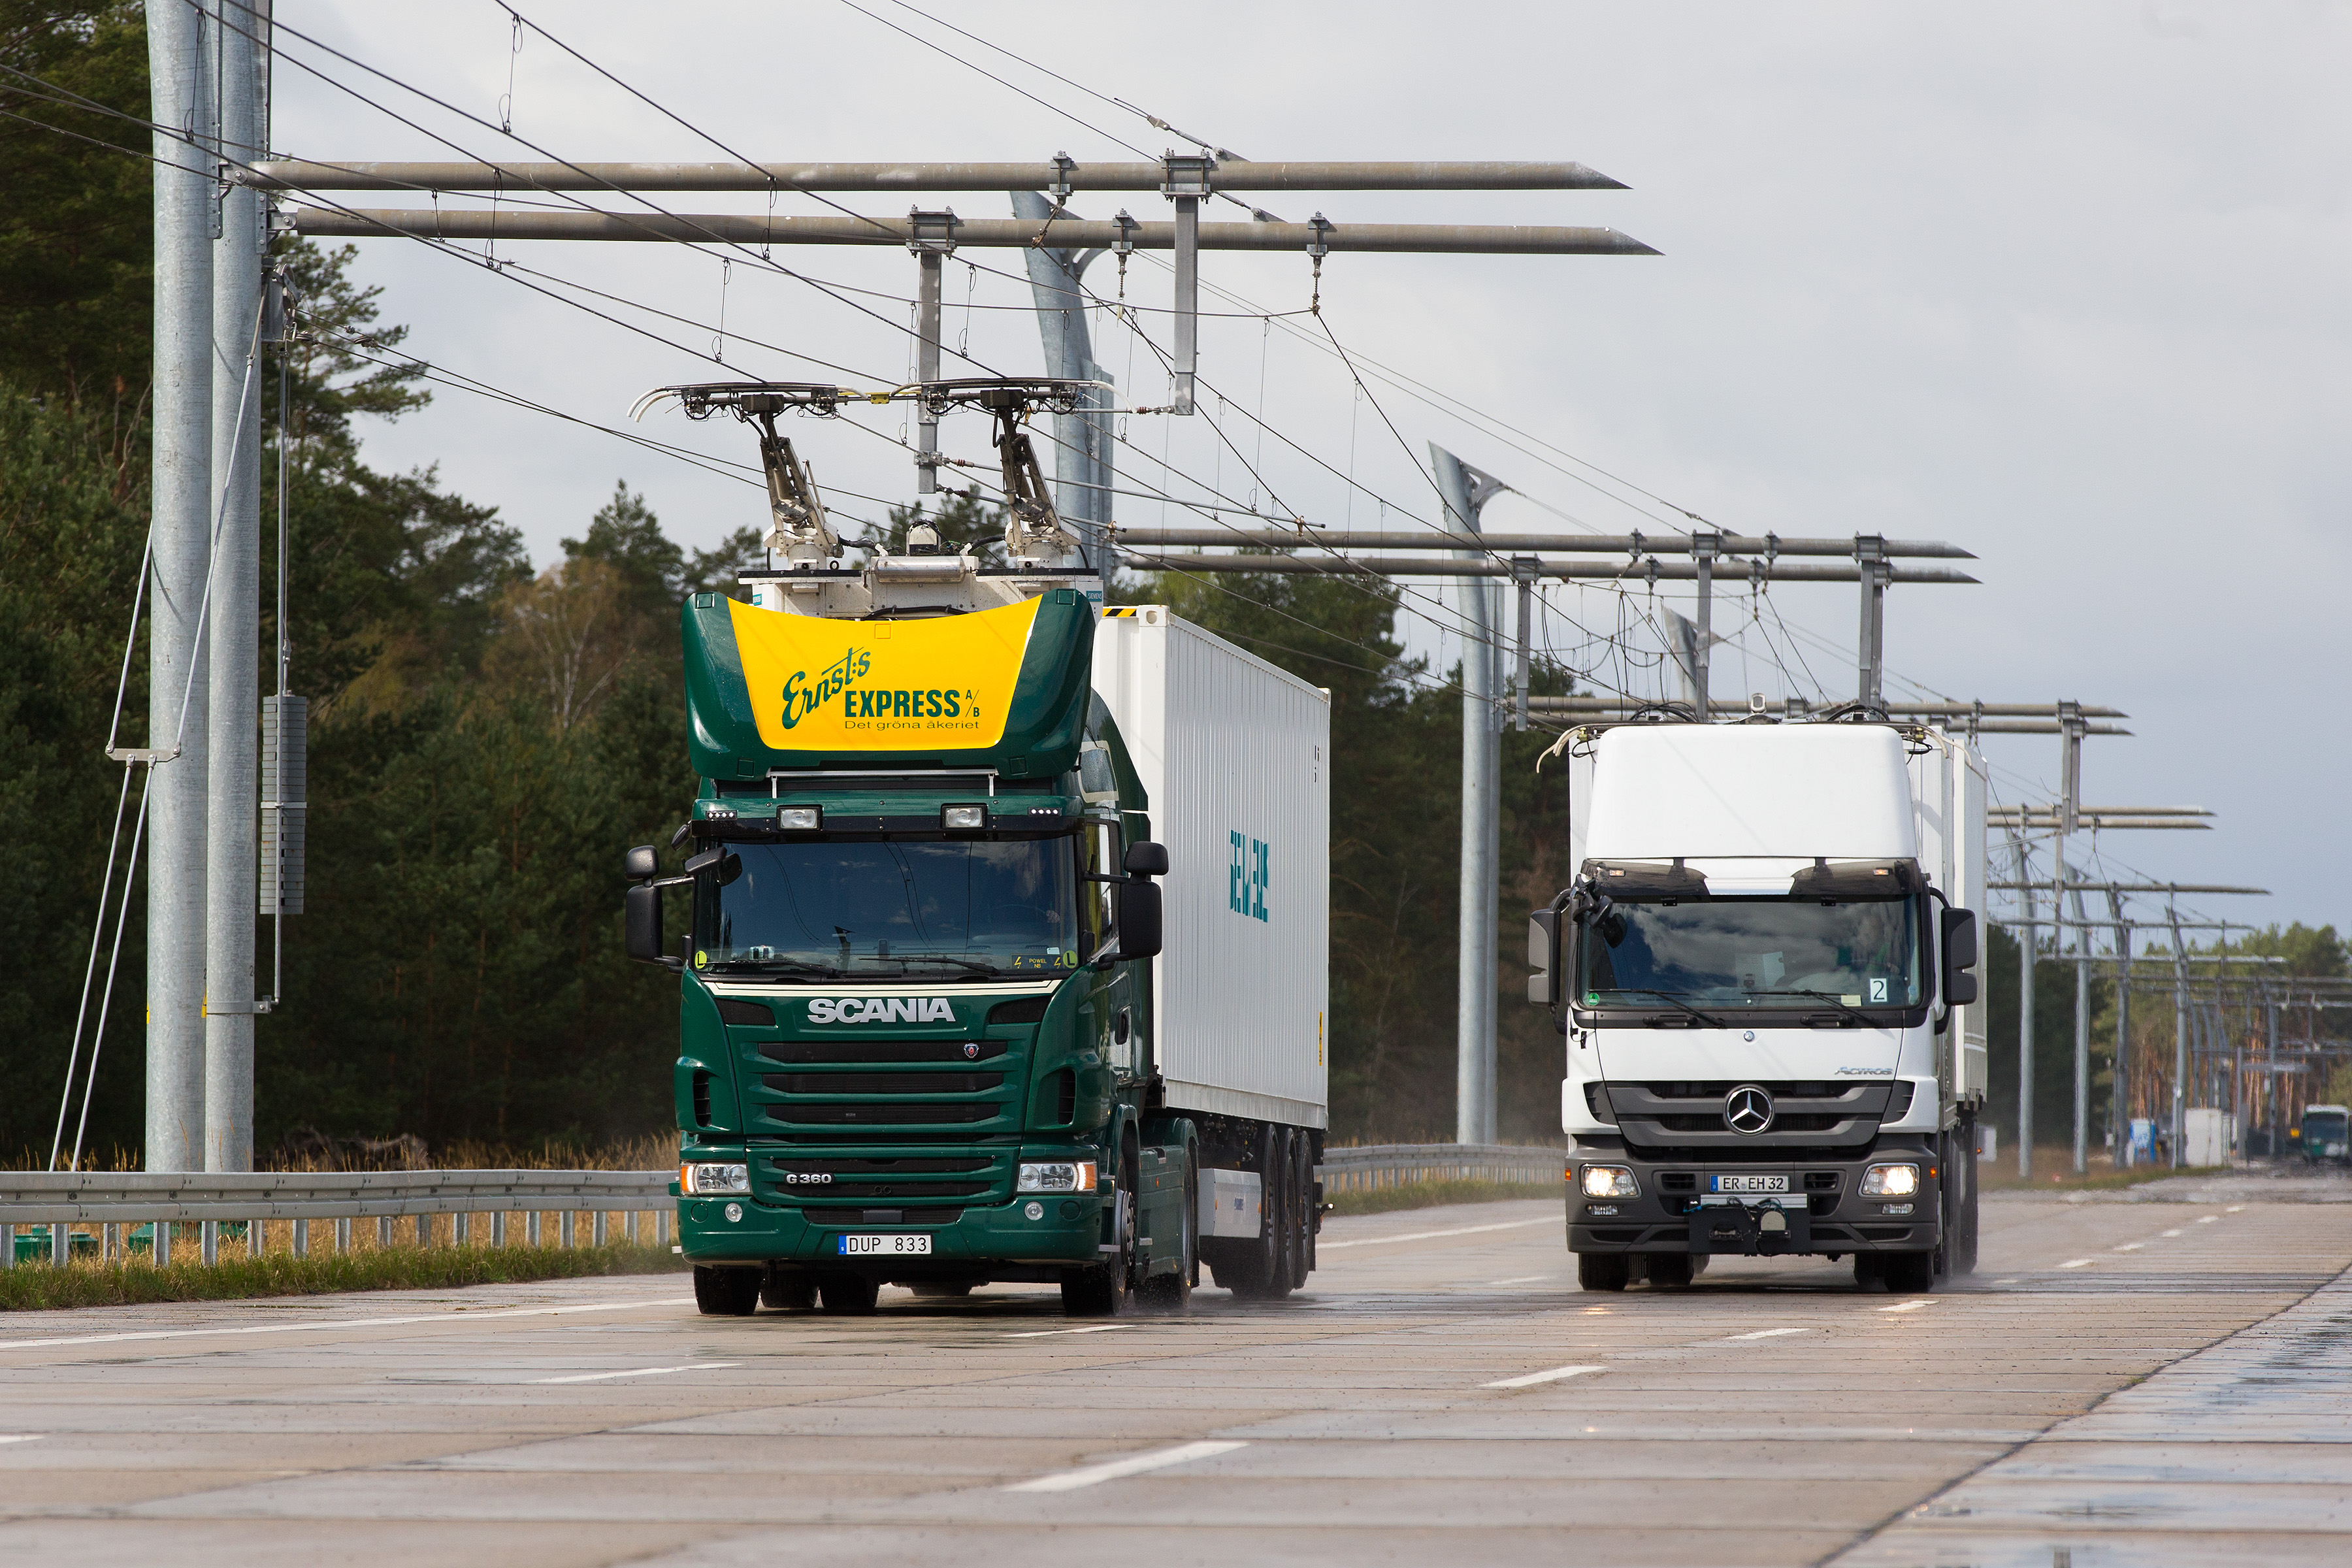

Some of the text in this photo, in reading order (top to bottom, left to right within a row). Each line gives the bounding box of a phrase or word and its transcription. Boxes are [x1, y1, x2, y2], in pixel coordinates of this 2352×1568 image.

[782, 647, 871, 729] Ernst:s
[845, 689, 960, 717] EXPRESS
[845, 720, 979, 731] Det gröna åkeriet
[1066, 953, 1075, 966] L
[1873, 980, 1885, 1000] 2
[808, 998, 956, 1024] SCANIA
[786, 1173, 832, 1184] G 360
[1723, 1177, 1739, 1190] ER
[1748, 1177, 1765, 1190] EH
[1768, 1177, 1784, 1190] 32
[849, 1237, 881, 1252] DUP
[895, 1237, 926, 1252] 833
